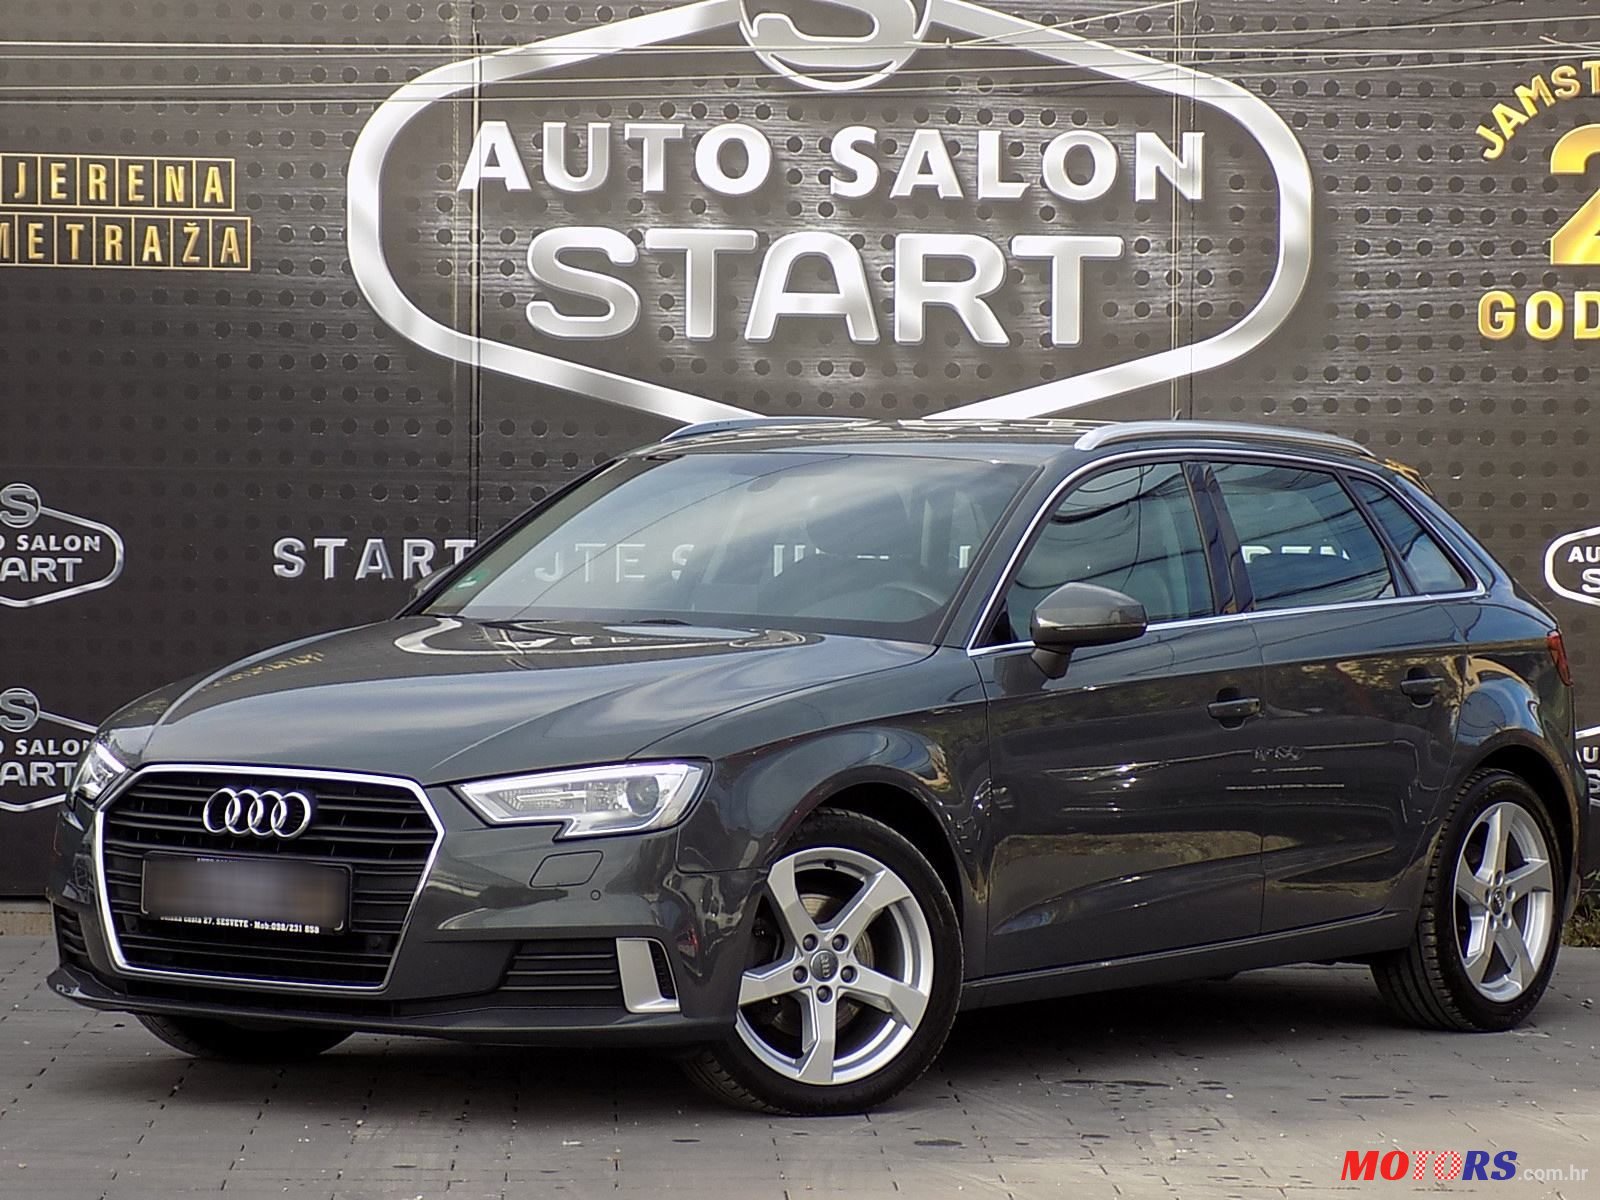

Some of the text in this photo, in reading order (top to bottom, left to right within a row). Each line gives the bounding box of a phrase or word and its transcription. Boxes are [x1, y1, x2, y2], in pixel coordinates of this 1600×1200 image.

[14, 161, 225, 204] JERENA
[456, 120, 1205, 202] AUTO SALON
[525, 226, 1125, 347] START
[1477, 290, 1600, 341] GOD
[16, 534, 101, 552] SALON
